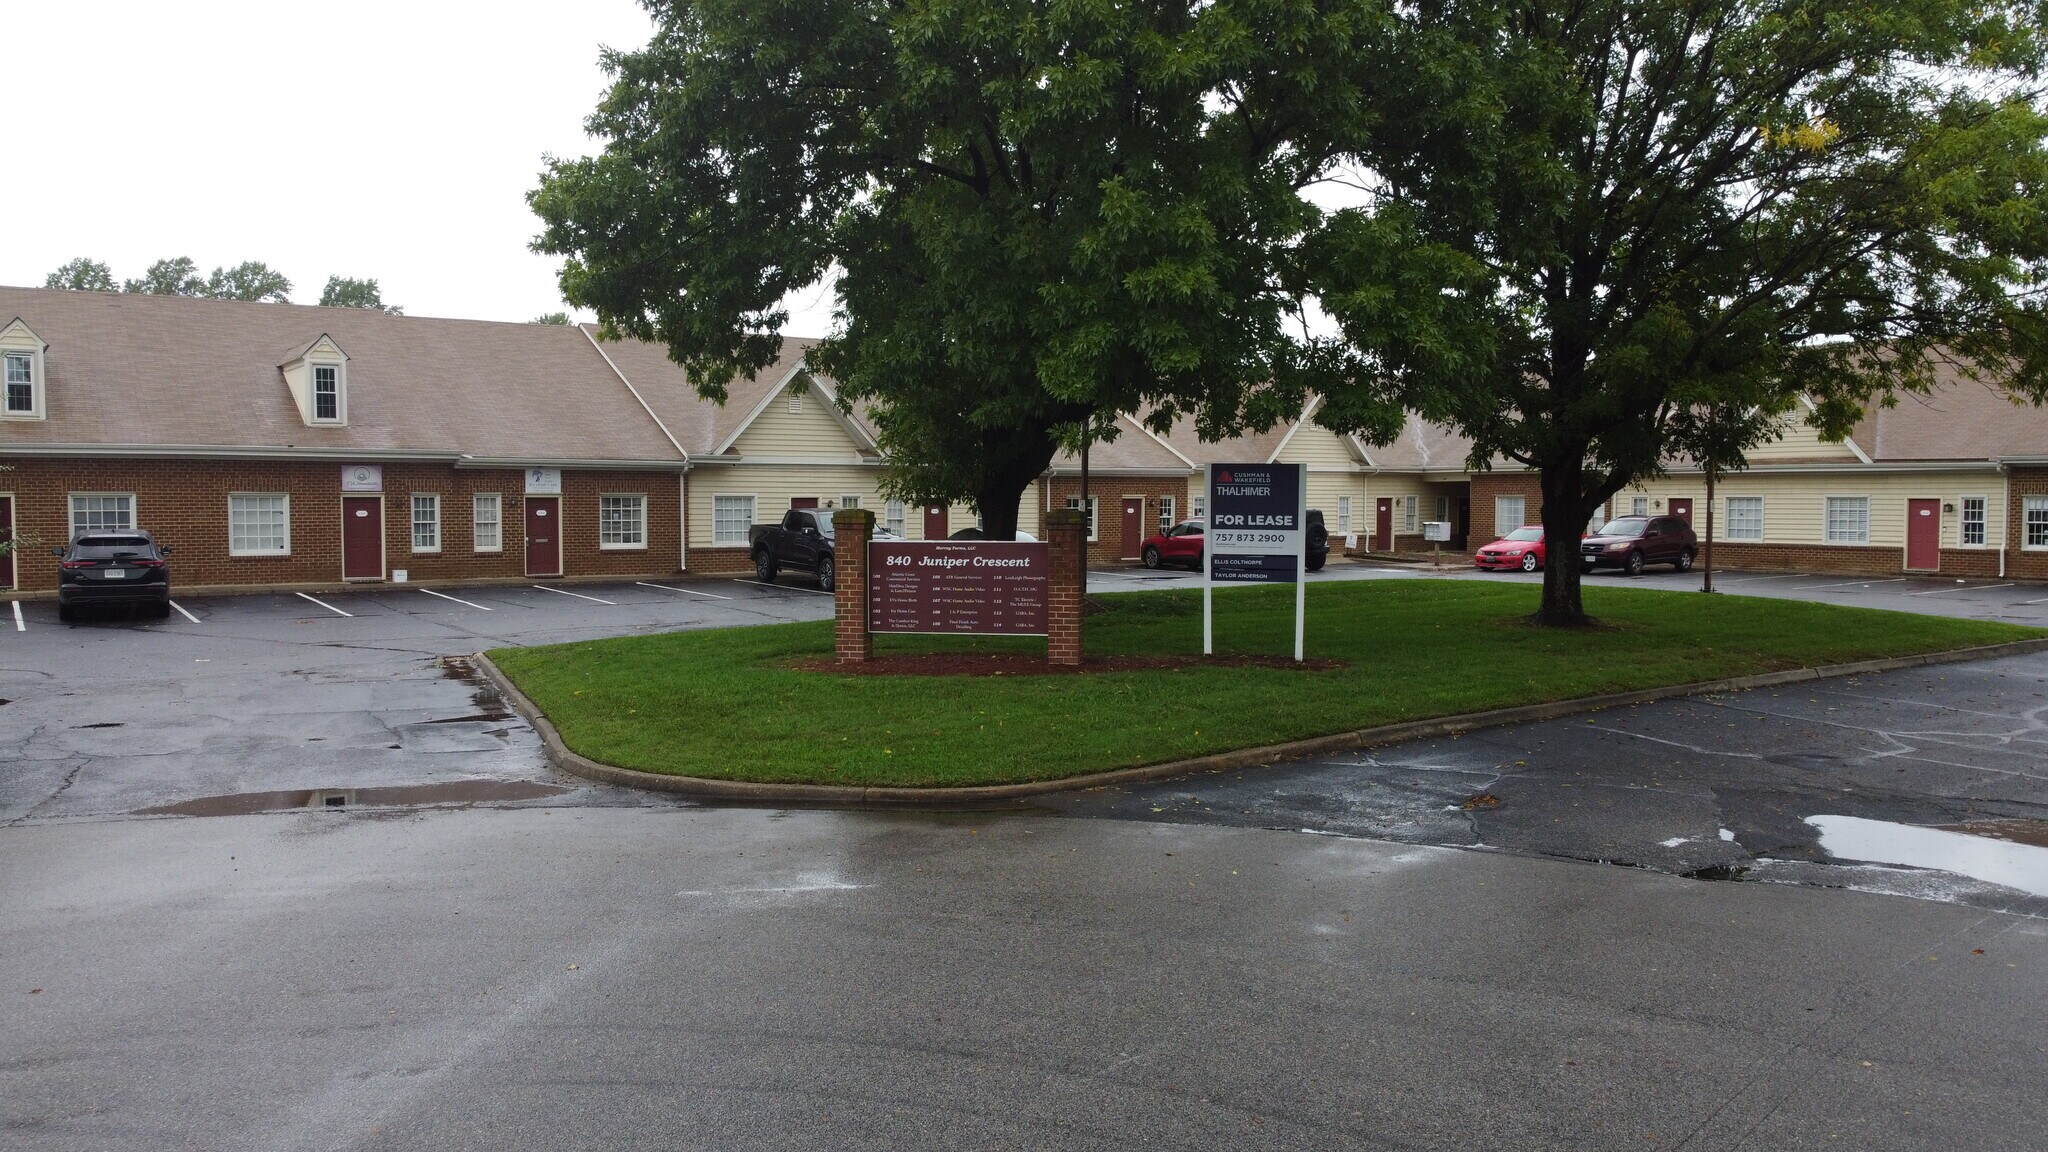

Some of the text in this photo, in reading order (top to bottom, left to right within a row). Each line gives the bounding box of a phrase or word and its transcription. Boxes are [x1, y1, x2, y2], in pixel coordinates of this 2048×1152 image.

[1217, 487, 1270, 496] THALHIMER
[1216, 515, 1292, 525] FOR LEASE
[886, 556, 1030, 568] 840 Juniper Crescent
